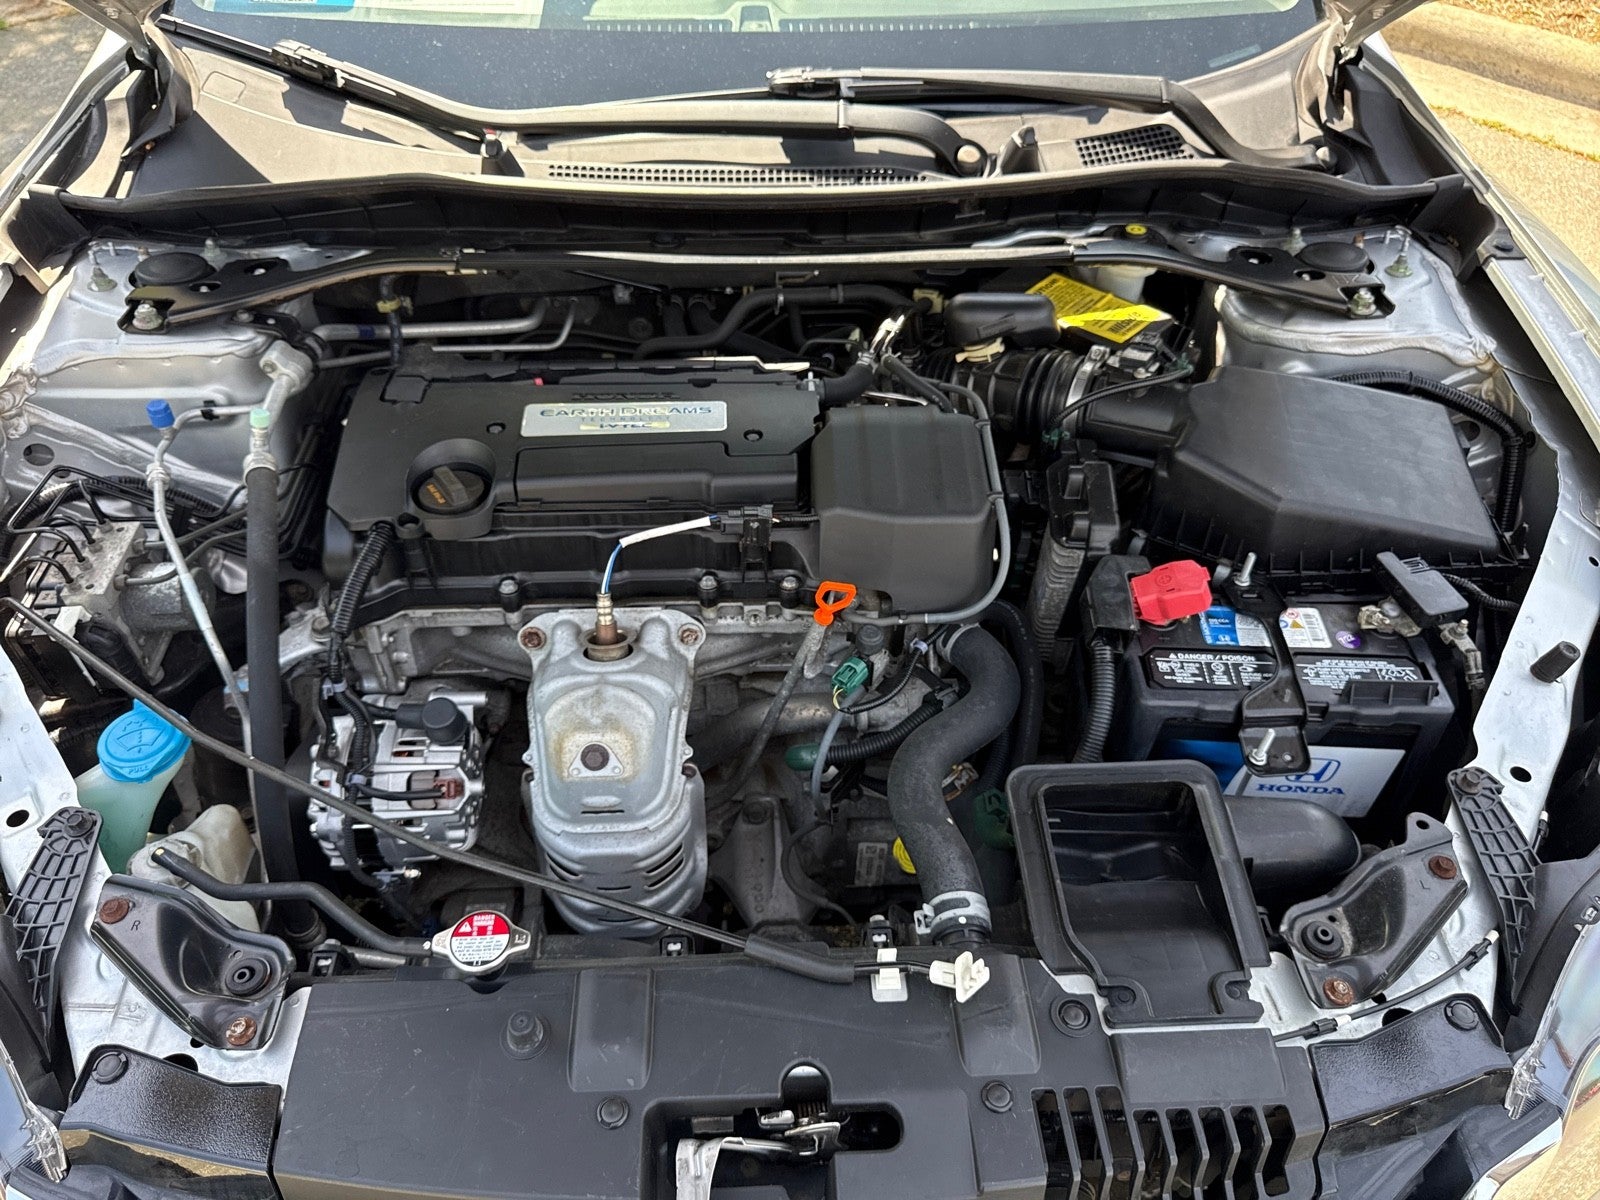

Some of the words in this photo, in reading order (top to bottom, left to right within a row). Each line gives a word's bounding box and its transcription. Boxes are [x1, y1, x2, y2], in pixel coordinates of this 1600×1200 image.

[540, 407, 615, 417] EARTH
[1256, 784, 1345, 795] HONDA
[131, 920, 141, 931] R
